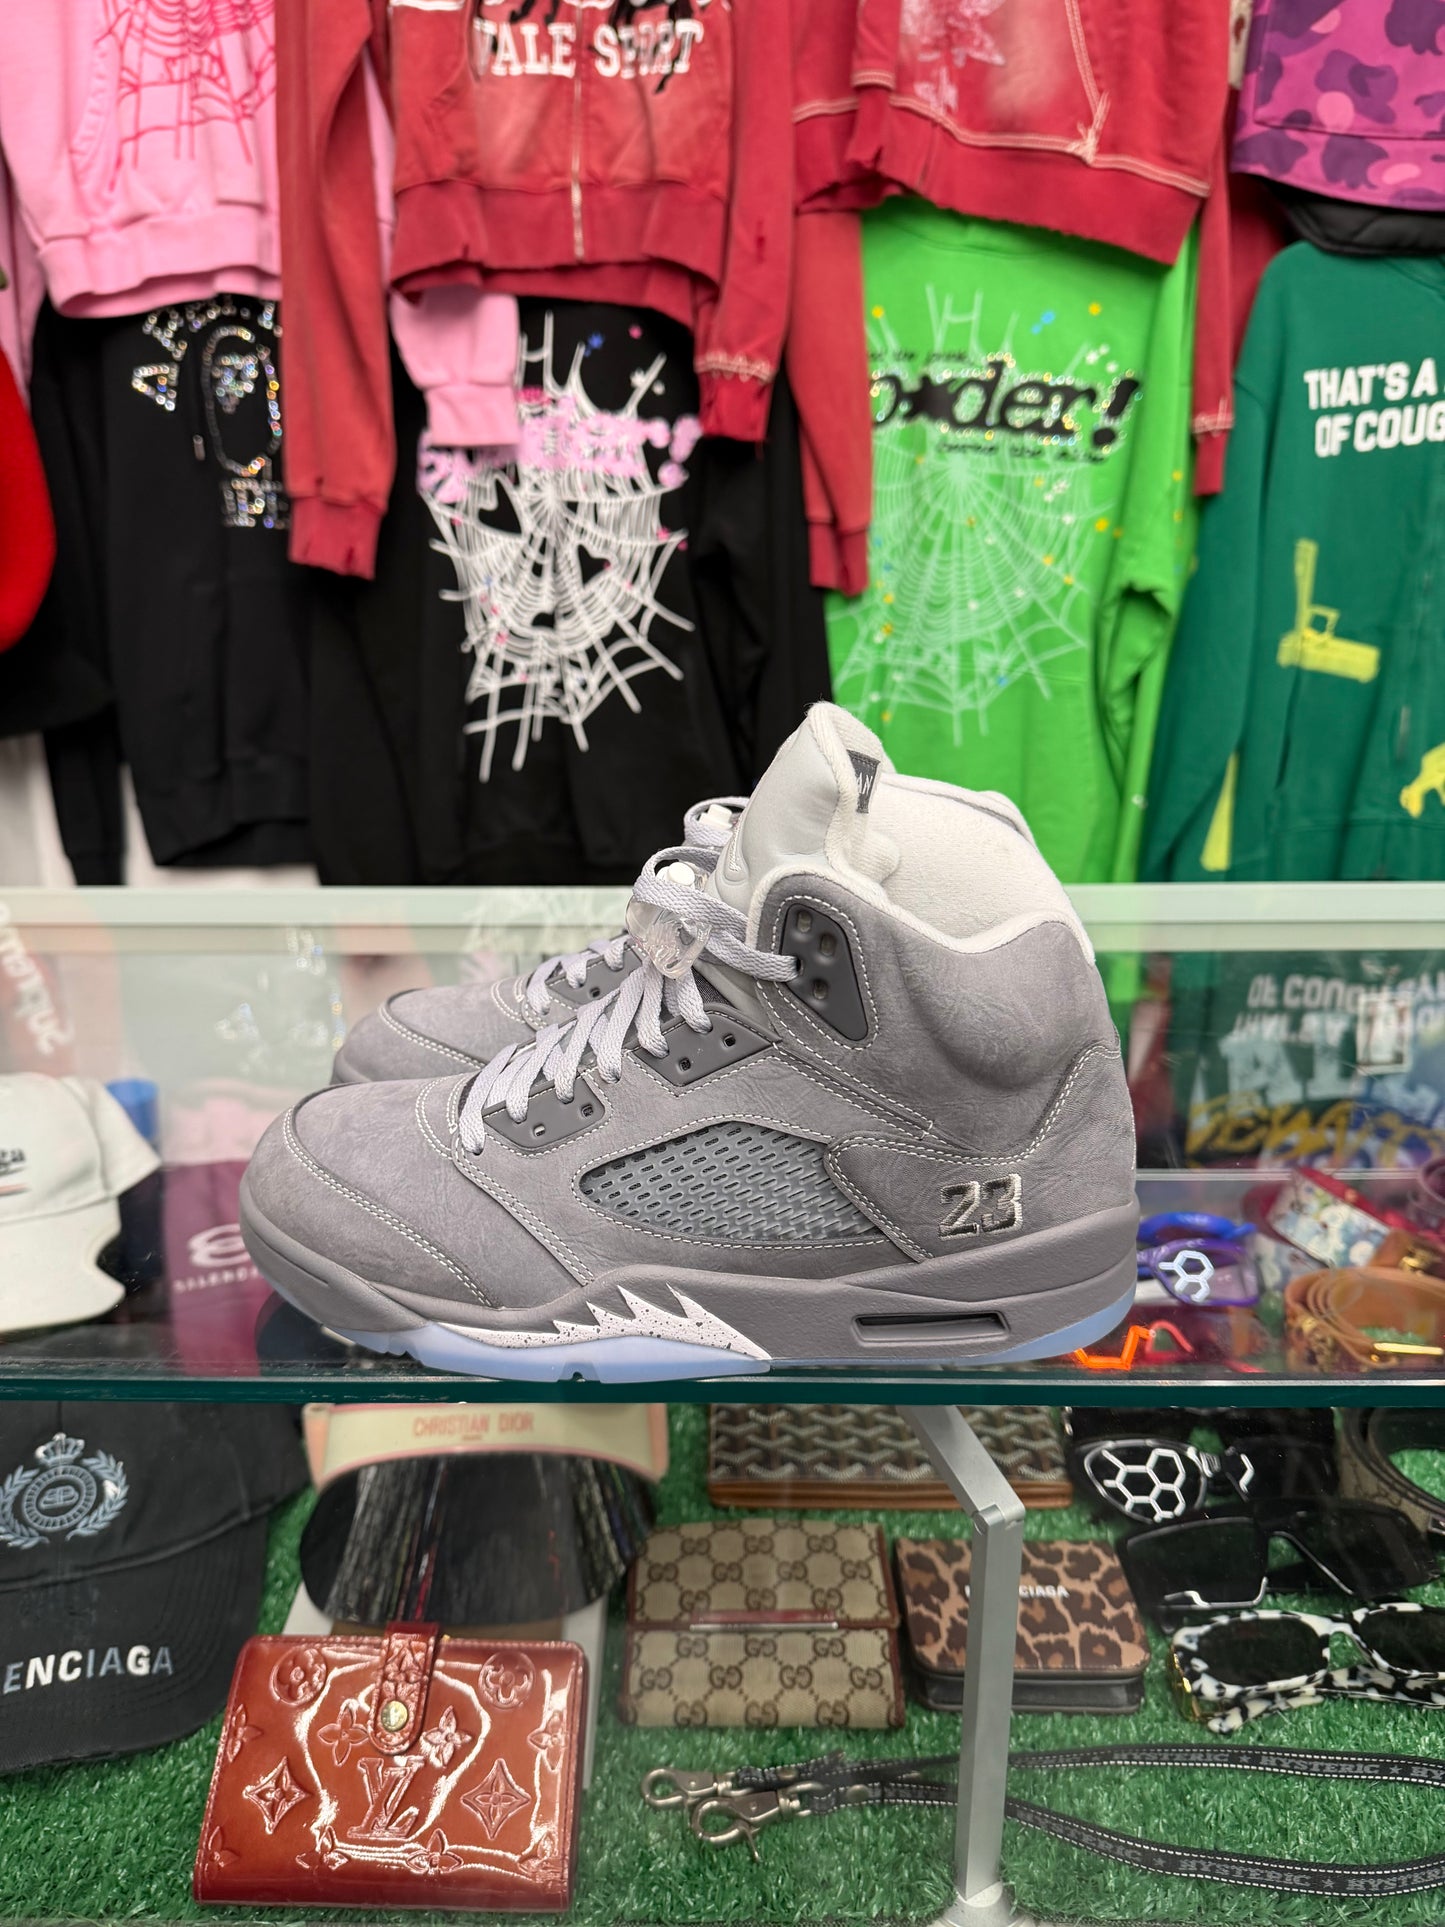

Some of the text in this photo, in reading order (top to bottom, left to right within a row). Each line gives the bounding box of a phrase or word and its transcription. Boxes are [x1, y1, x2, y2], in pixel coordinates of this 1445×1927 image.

[1303, 357, 1438, 410] THAT'S A
[1314, 412, 1353, 458] OF
[939, 1173, 1023, 1240] 23
[498, 1411, 534, 1432] DIOR
[3, 1645, 173, 1694] ENCIAGA
[1259, 1755, 1380, 1774] HYSTERIC
[1178, 1859, 1312, 1888] HYSTERIC
